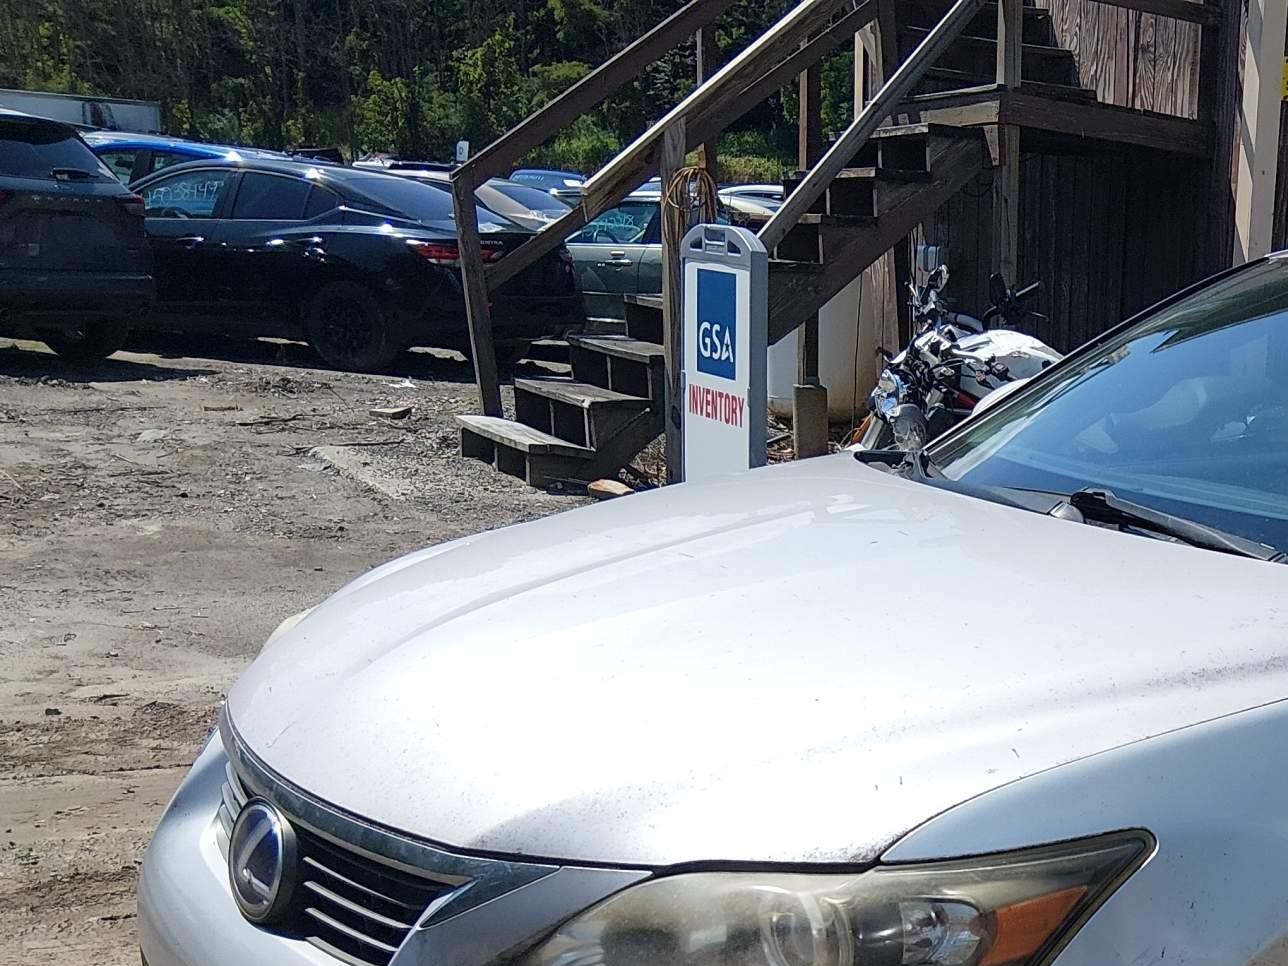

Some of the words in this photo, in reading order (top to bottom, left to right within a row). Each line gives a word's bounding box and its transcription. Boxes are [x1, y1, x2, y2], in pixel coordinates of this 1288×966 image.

[479, 239, 505, 247] ENTRA
[699, 321, 734, 363] GSA
[689, 384, 745, 428] INVENTORY
